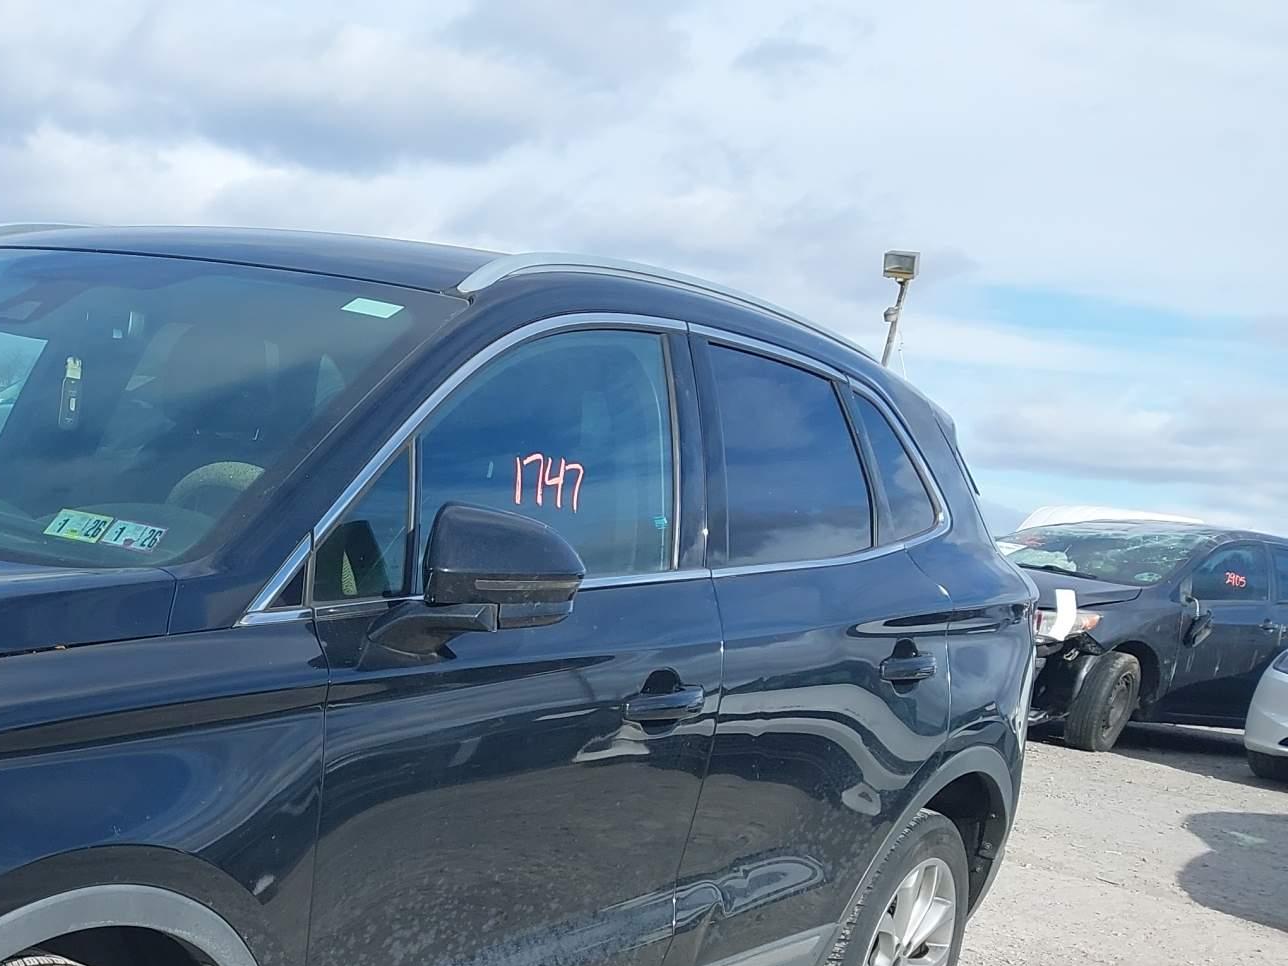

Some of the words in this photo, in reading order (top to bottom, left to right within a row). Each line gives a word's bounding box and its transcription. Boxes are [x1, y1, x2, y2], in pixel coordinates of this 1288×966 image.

[515, 453, 584, 514] 1747
[84, 519, 108, 538] 26
[139, 528, 163, 548] 26
